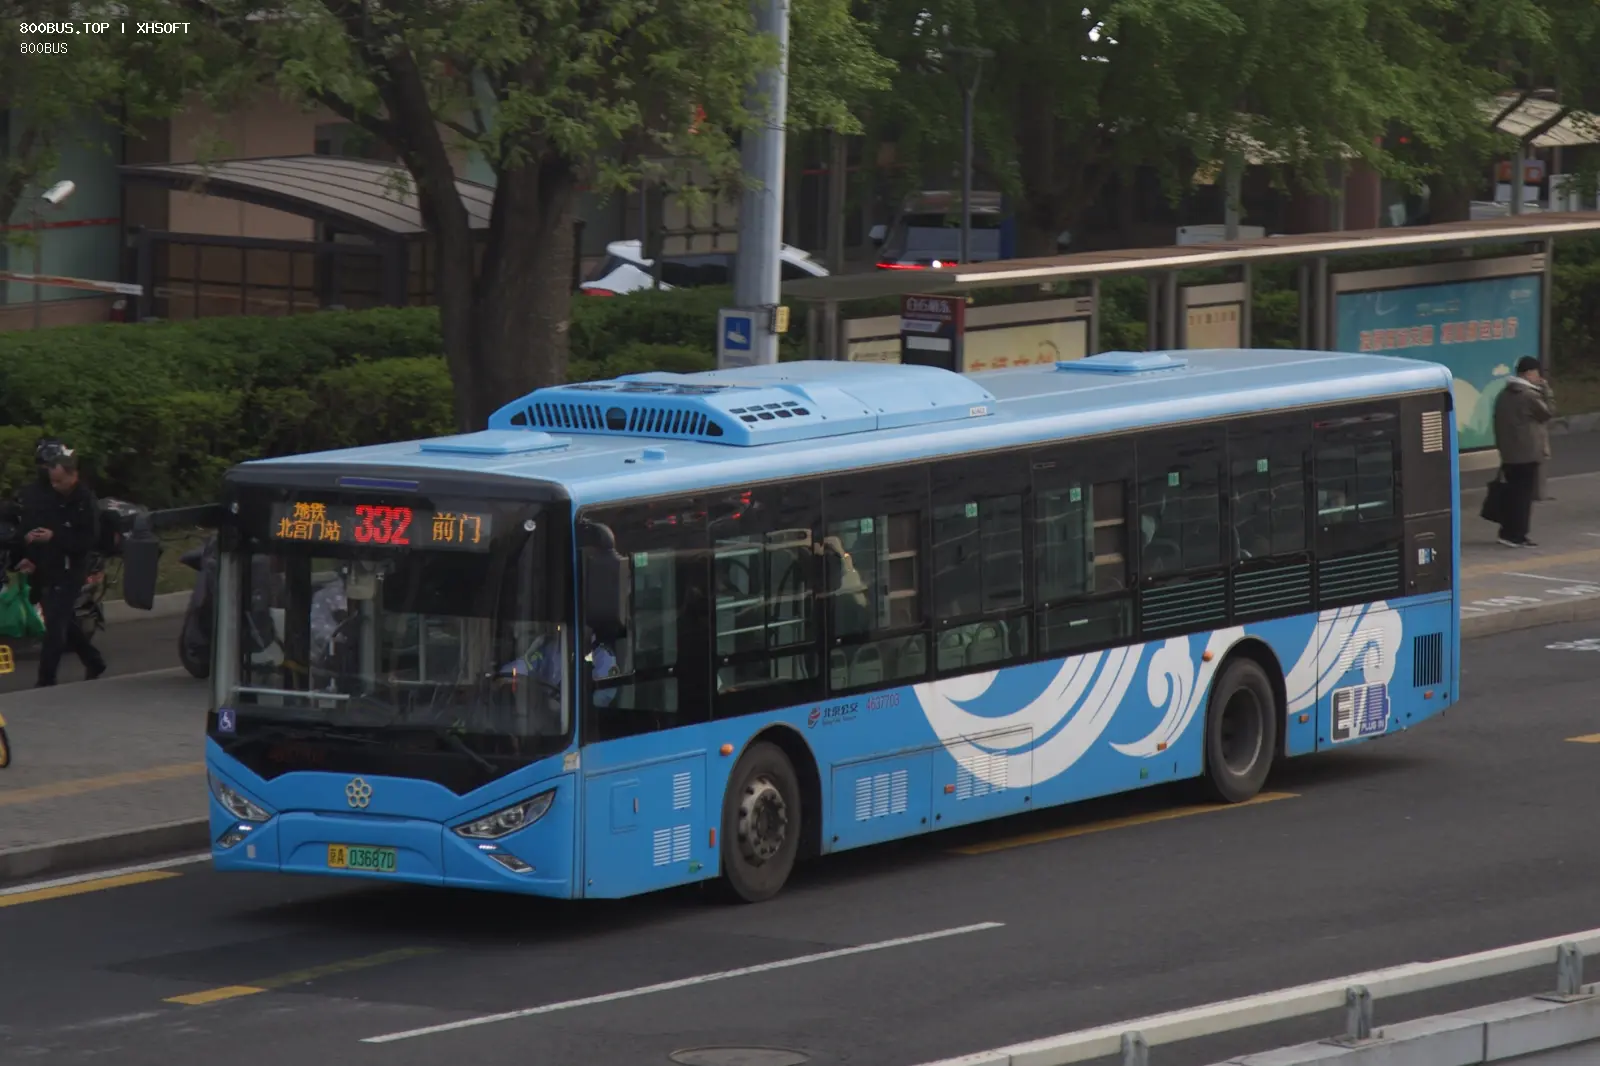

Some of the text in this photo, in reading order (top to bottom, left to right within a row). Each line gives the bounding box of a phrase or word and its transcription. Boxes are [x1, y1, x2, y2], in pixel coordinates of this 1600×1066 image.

[293, 502, 326, 521] 地铁
[276, 517, 341, 541] 北宫门站
[355, 504, 414, 545] 332
[432, 512, 481, 544] 前门
[823, 702, 858, 718] 北京公交
